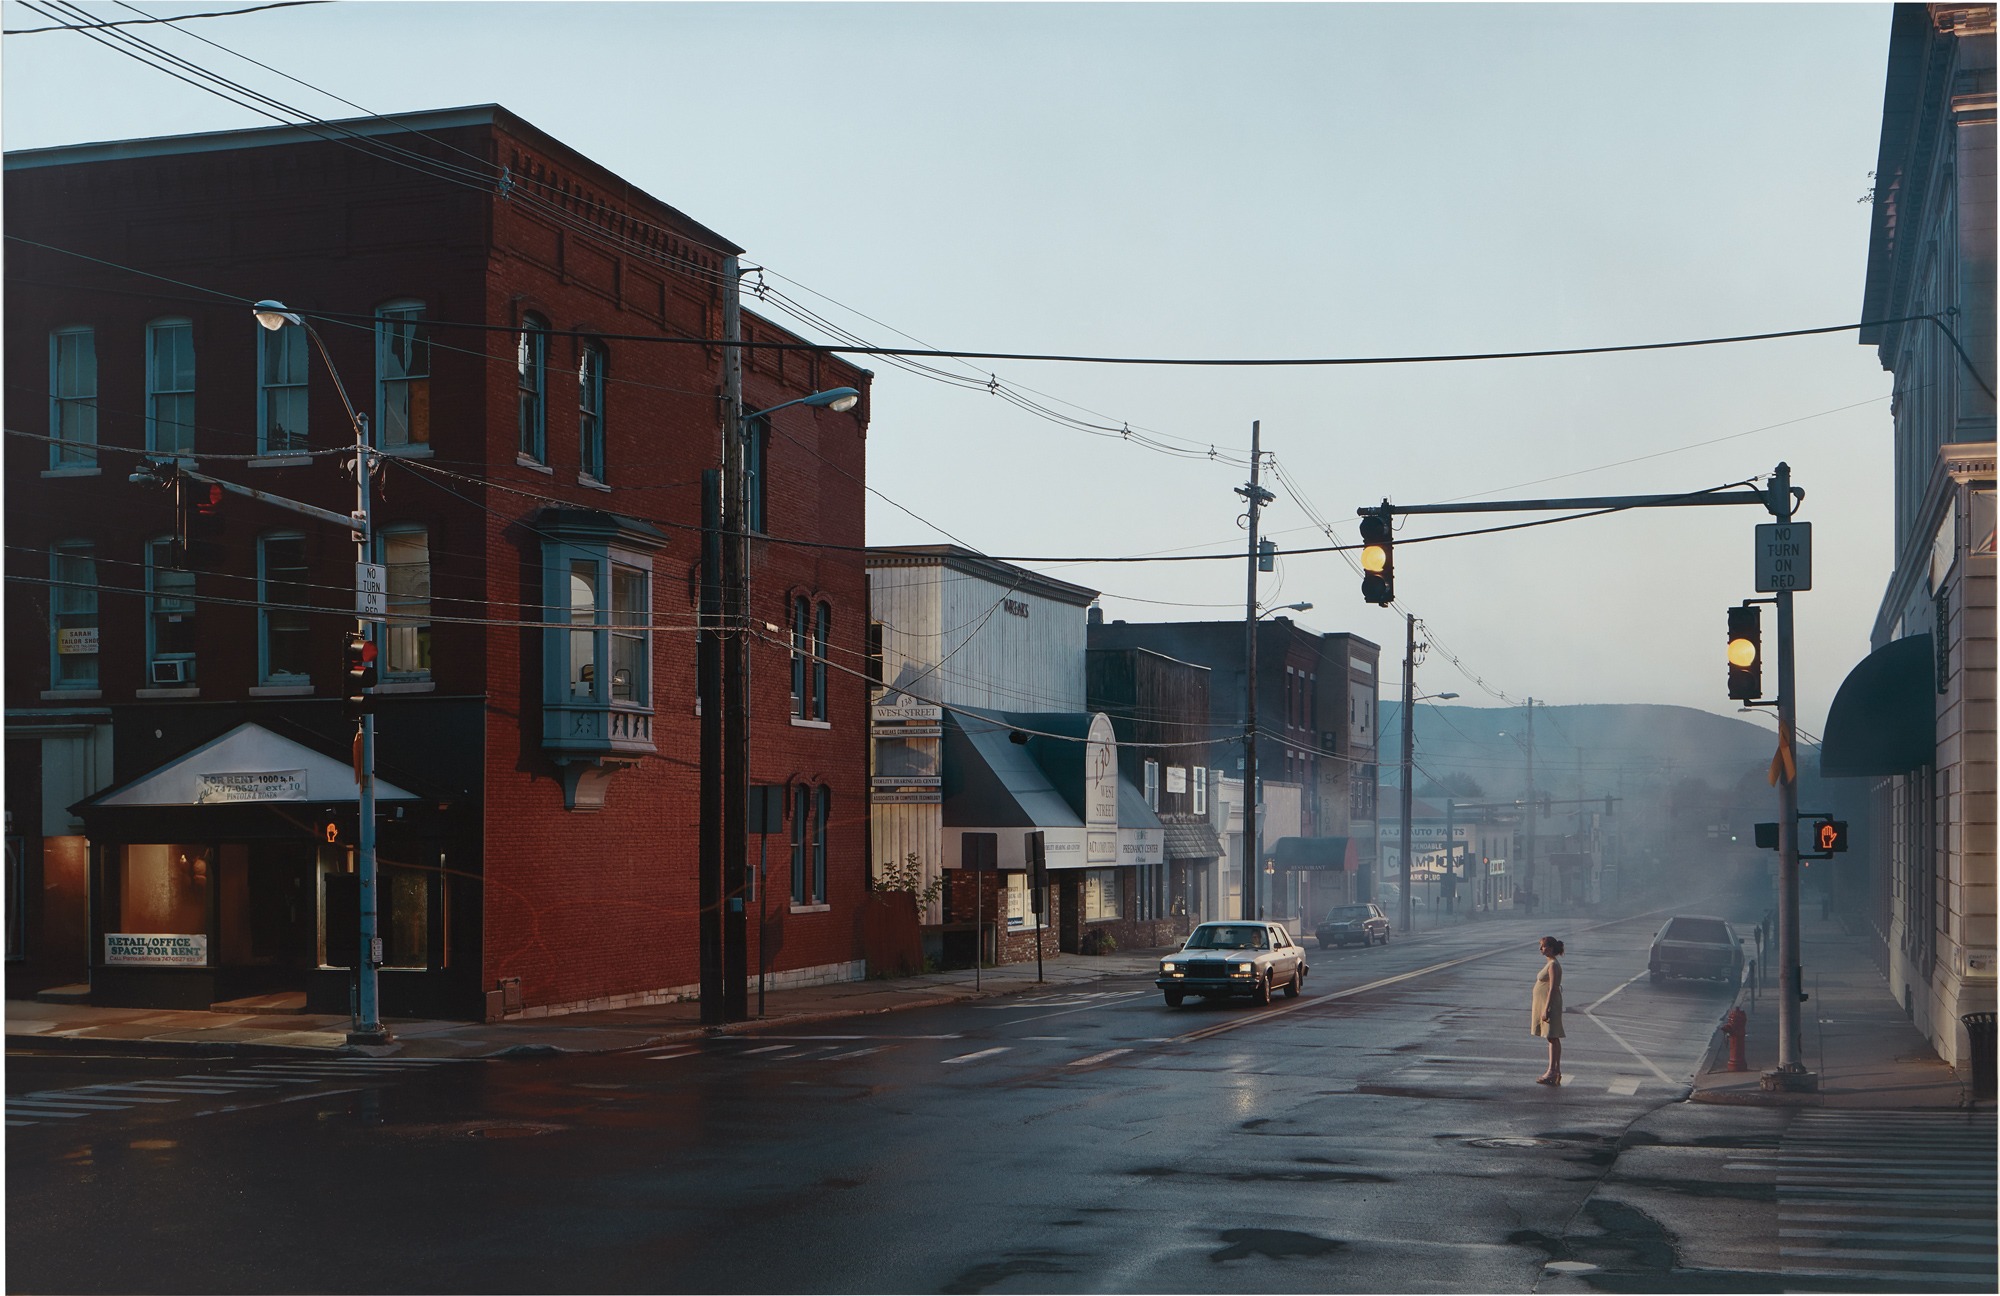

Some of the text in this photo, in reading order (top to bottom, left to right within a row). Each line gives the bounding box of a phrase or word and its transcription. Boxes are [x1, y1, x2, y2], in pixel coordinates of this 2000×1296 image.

[1775, 528, 1791, 541] NO
[1767, 543, 1799, 557] TURN
[1775, 559, 1792, 572] ON
[367, 568, 376, 579] NO
[363, 580, 380, 592] TURN
[1771, 574, 1795, 588] RED
[367, 594, 377, 605] ON
[901, 697, 913, 707] 138
[878, 708, 936, 717] WEST STREET
[1095, 737, 1110, 790] 138
[204, 776, 225, 784] FOR
[226, 775, 254, 784] RENT
[258, 775, 279, 783] 1000
[214, 784, 259, 792] 747-0527
[290, 782, 300, 791] 10
[1100, 785, 1114, 798] WEST
[1096, 804, 1114, 817] STREET
[1410, 828, 1432, 836] AUTO
[1436, 828, 1465, 836] PATS
[1123, 844, 1158, 854] PREGNANCY CENTER
[108, 937, 191, 947] RETAIL/OFFICE
[111, 947, 201, 956] SPACE FOR RENT
